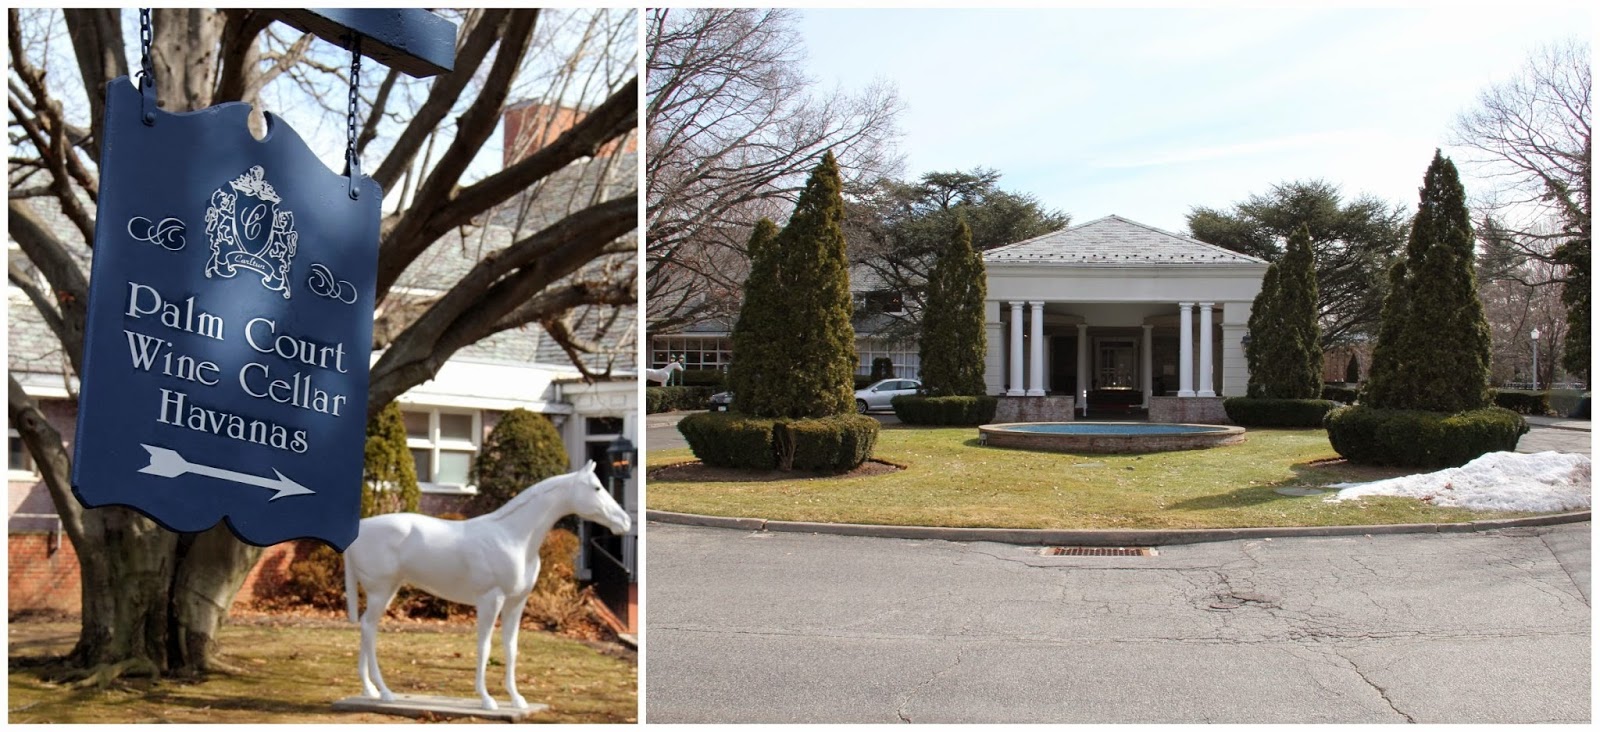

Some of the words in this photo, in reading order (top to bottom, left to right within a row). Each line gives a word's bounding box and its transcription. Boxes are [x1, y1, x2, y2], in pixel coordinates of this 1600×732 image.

[125, 281, 224, 341] Palm
[244, 317, 348, 374] Court
[123, 329, 221, 386] Wine
[239, 362, 347, 417] Cellar
[156, 387, 309, 454] Havanas
